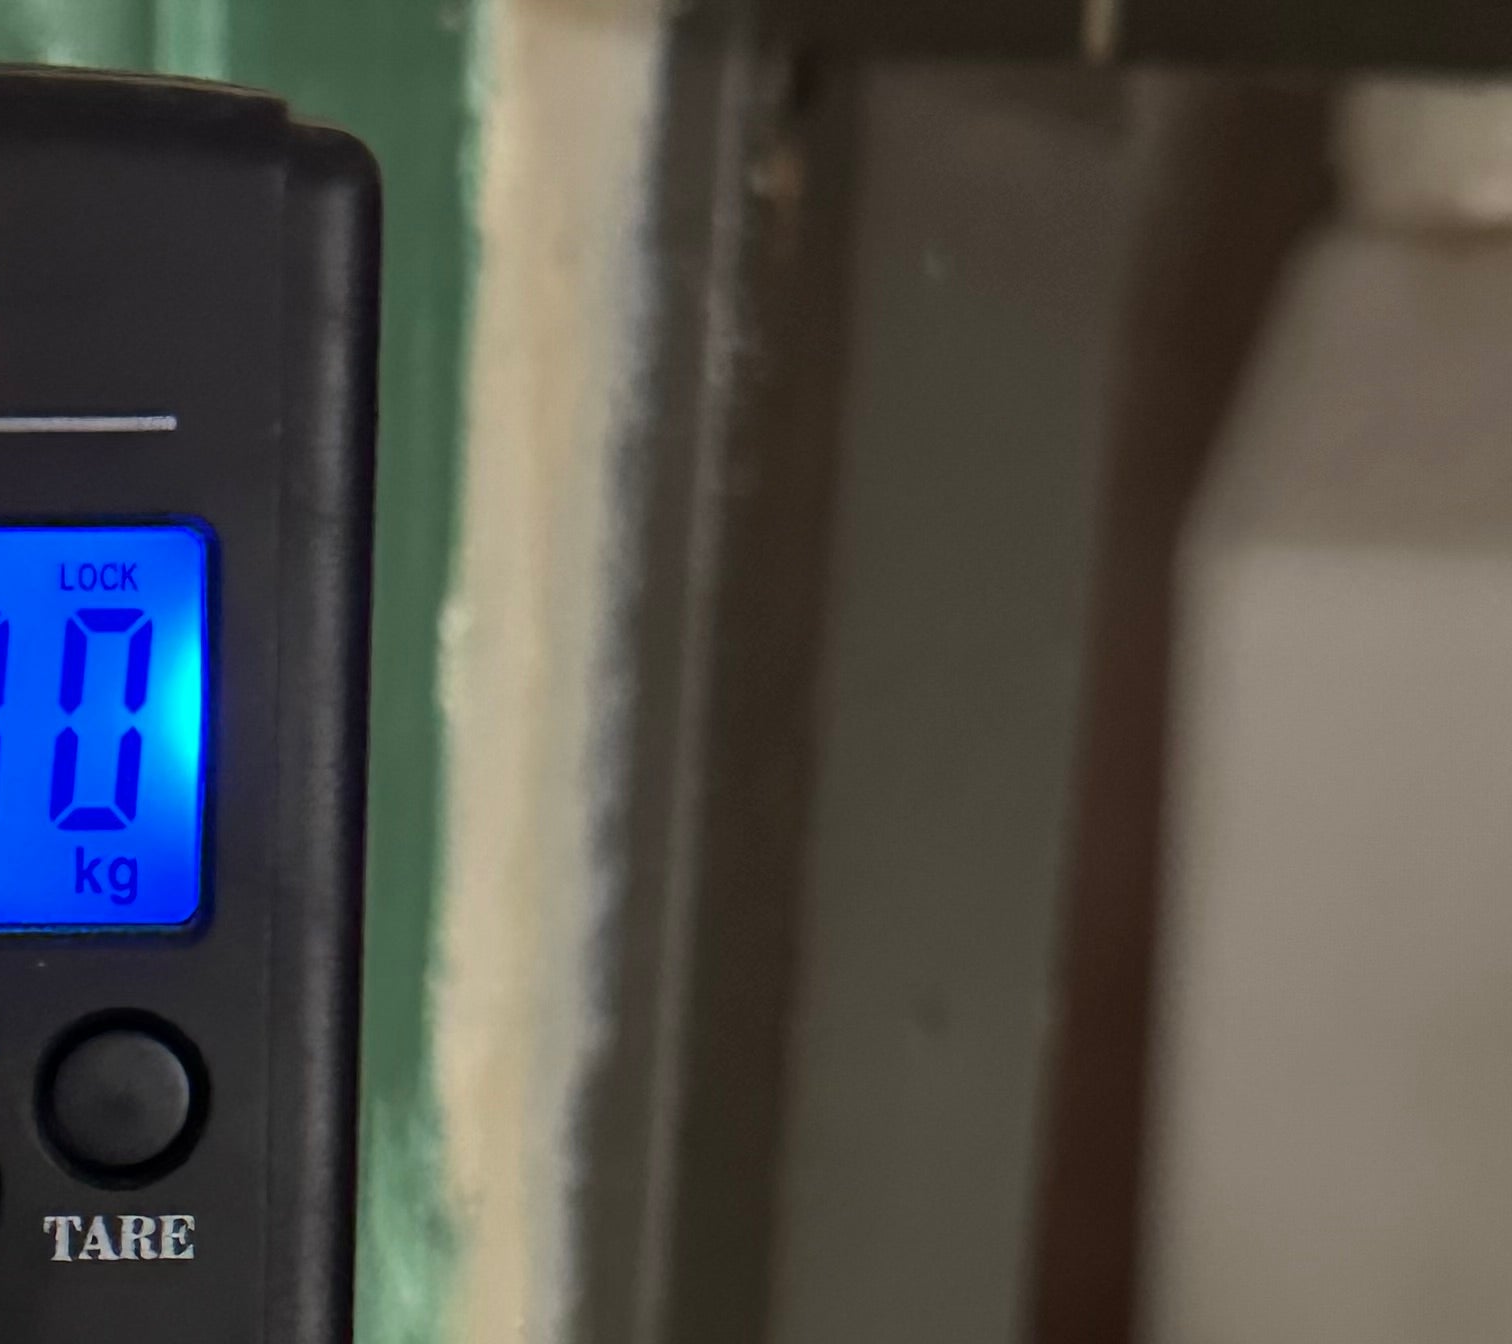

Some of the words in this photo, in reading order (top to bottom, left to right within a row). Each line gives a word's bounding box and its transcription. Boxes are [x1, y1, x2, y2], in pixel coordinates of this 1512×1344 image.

[58, 563, 139, 592] LOCK
[74, 847, 139, 905] kg
[42, 1214, 196, 1263] TARE
